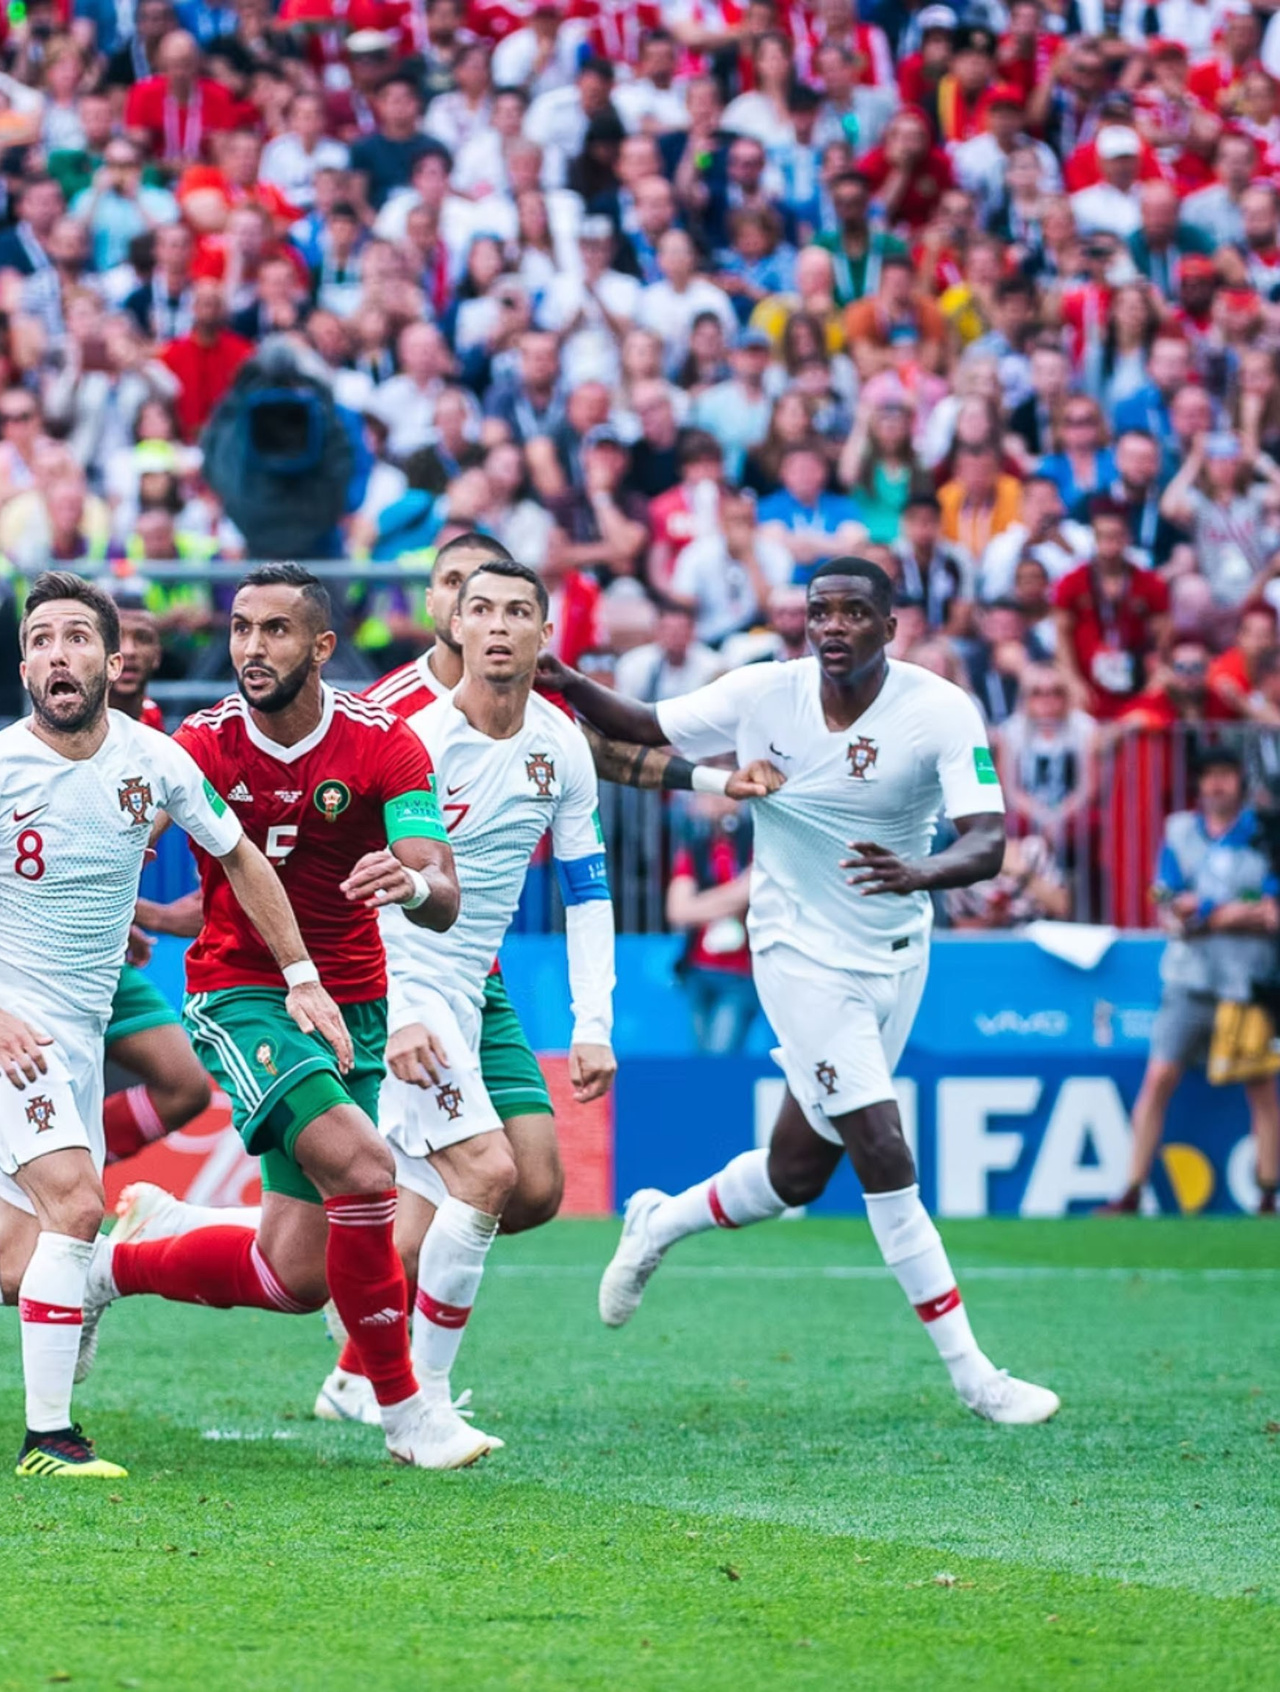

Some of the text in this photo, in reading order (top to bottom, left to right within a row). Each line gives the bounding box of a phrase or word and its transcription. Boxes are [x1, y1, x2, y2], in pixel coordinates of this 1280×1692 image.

[443, 803, 471, 833] 7
[14, 829, 46, 881] 8
[265, 825, 300, 866] 5
